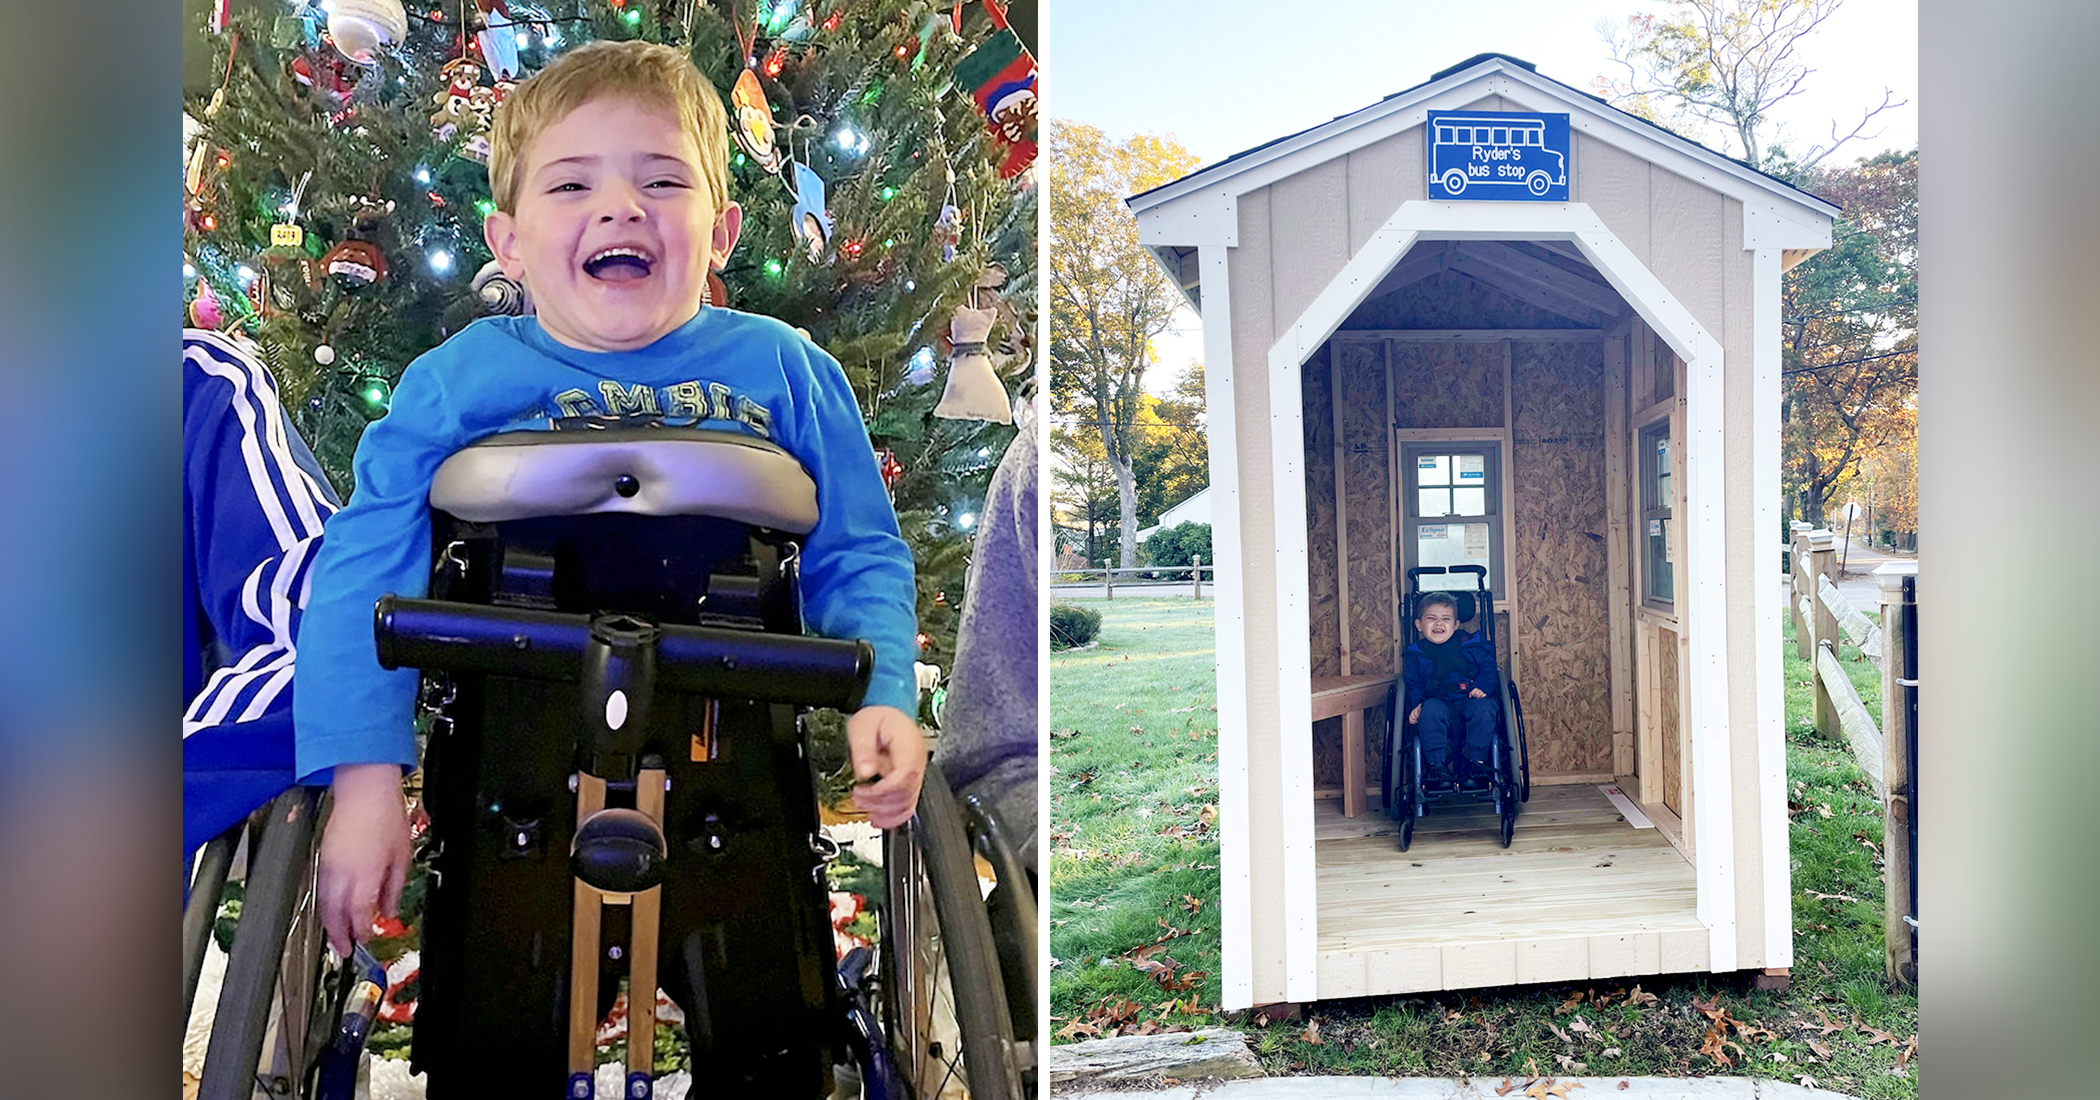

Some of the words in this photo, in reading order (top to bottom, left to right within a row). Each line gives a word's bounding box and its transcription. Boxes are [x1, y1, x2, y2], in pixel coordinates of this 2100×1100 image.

[1472, 145, 1522, 162] Ryder's
[1468, 162, 1491, 177] bus
[1497, 164, 1526, 180] stop
[1421, 526, 1446, 534] Eclipse
